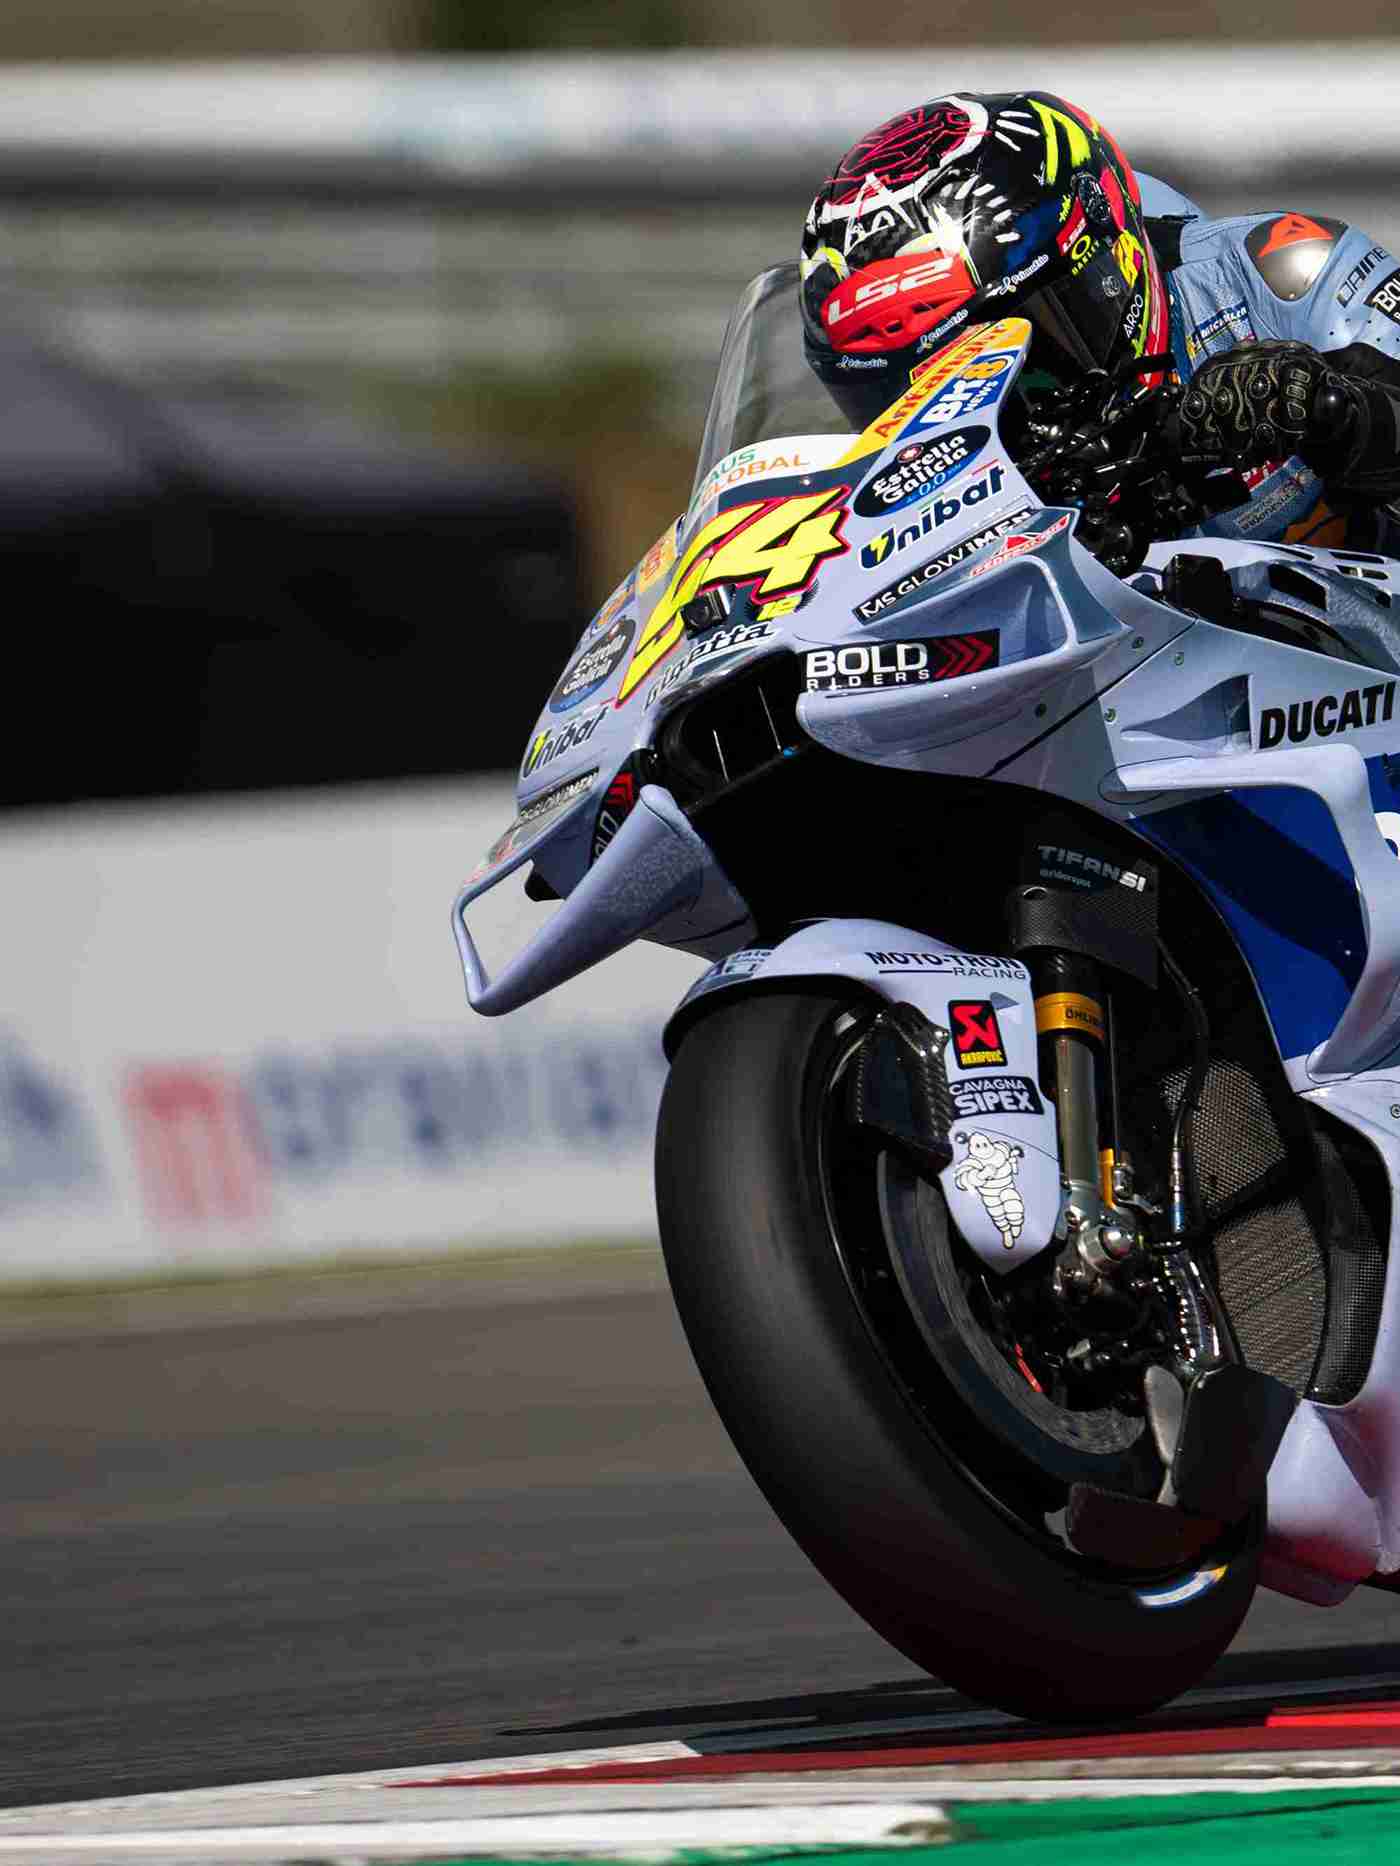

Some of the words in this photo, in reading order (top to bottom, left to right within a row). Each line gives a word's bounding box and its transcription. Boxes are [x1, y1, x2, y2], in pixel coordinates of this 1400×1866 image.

[828, 256, 954, 326] LS2
[1336, 246, 1390, 308] DAINE
[919, 359, 1010, 423] BK8
[872, 435, 966, 496] Estrella
[882, 447, 969, 503] Galicia
[860, 591, 897, 618] MS
[898, 548, 963, 595] GLOW
[805, 642, 929, 678] BOLD
[806, 669, 931, 691] RIDERS
[1258, 682, 1397, 750] DUCATI
[866, 951, 1022, 970] MOTO-TRON
[953, 966, 1027, 980] RACING
[949, 1079, 1027, 1096] CAVAGNA
[954, 1090, 1035, 1116] SIPEX
